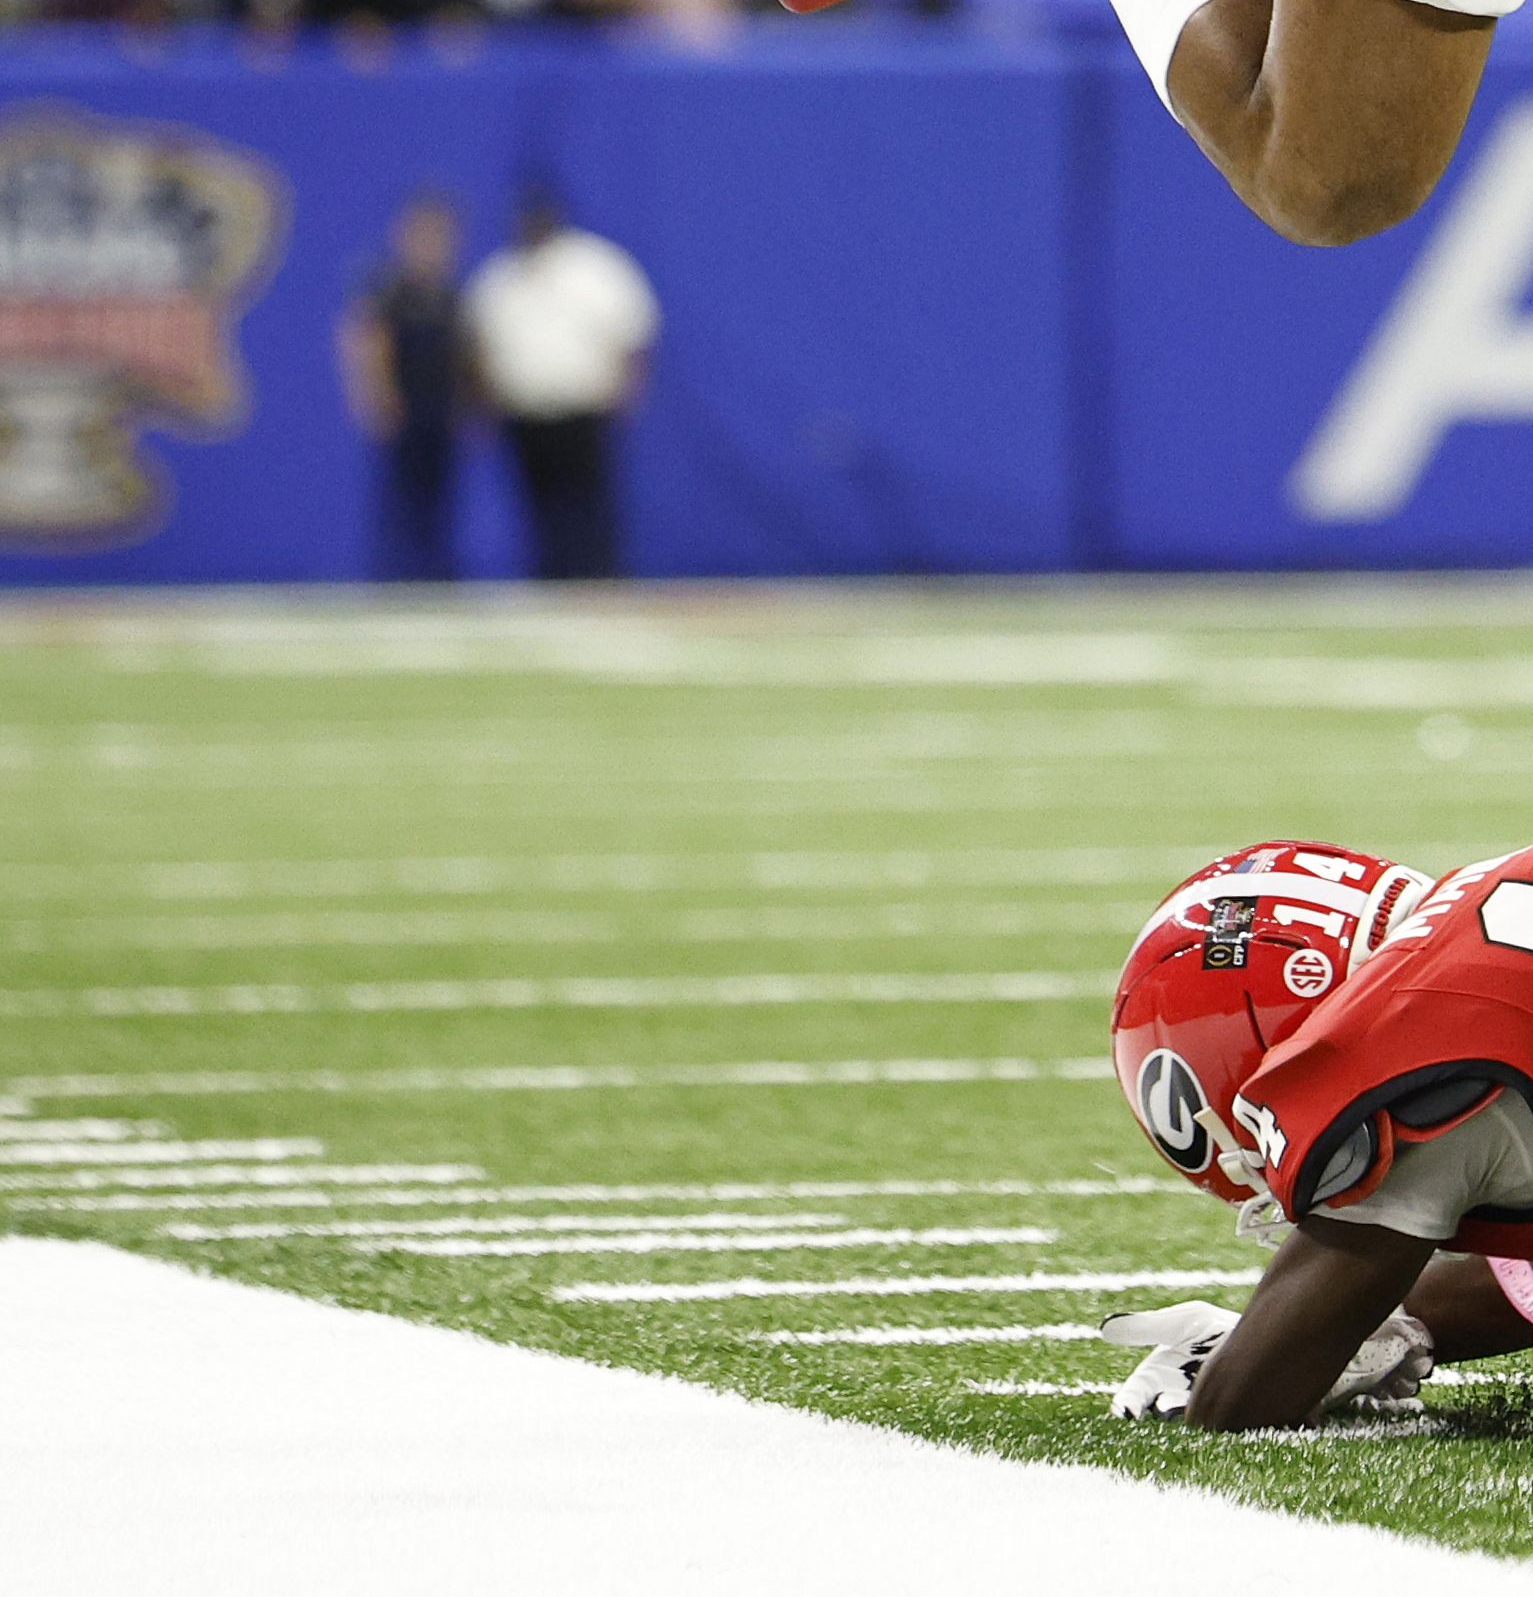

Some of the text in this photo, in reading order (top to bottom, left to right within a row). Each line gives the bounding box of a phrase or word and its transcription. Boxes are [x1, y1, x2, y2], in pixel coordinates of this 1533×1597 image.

[1273, 851, 1367, 939] 14
[1290, 954, 1327, 991] SEC
[1142, 1049, 1207, 1168] G
